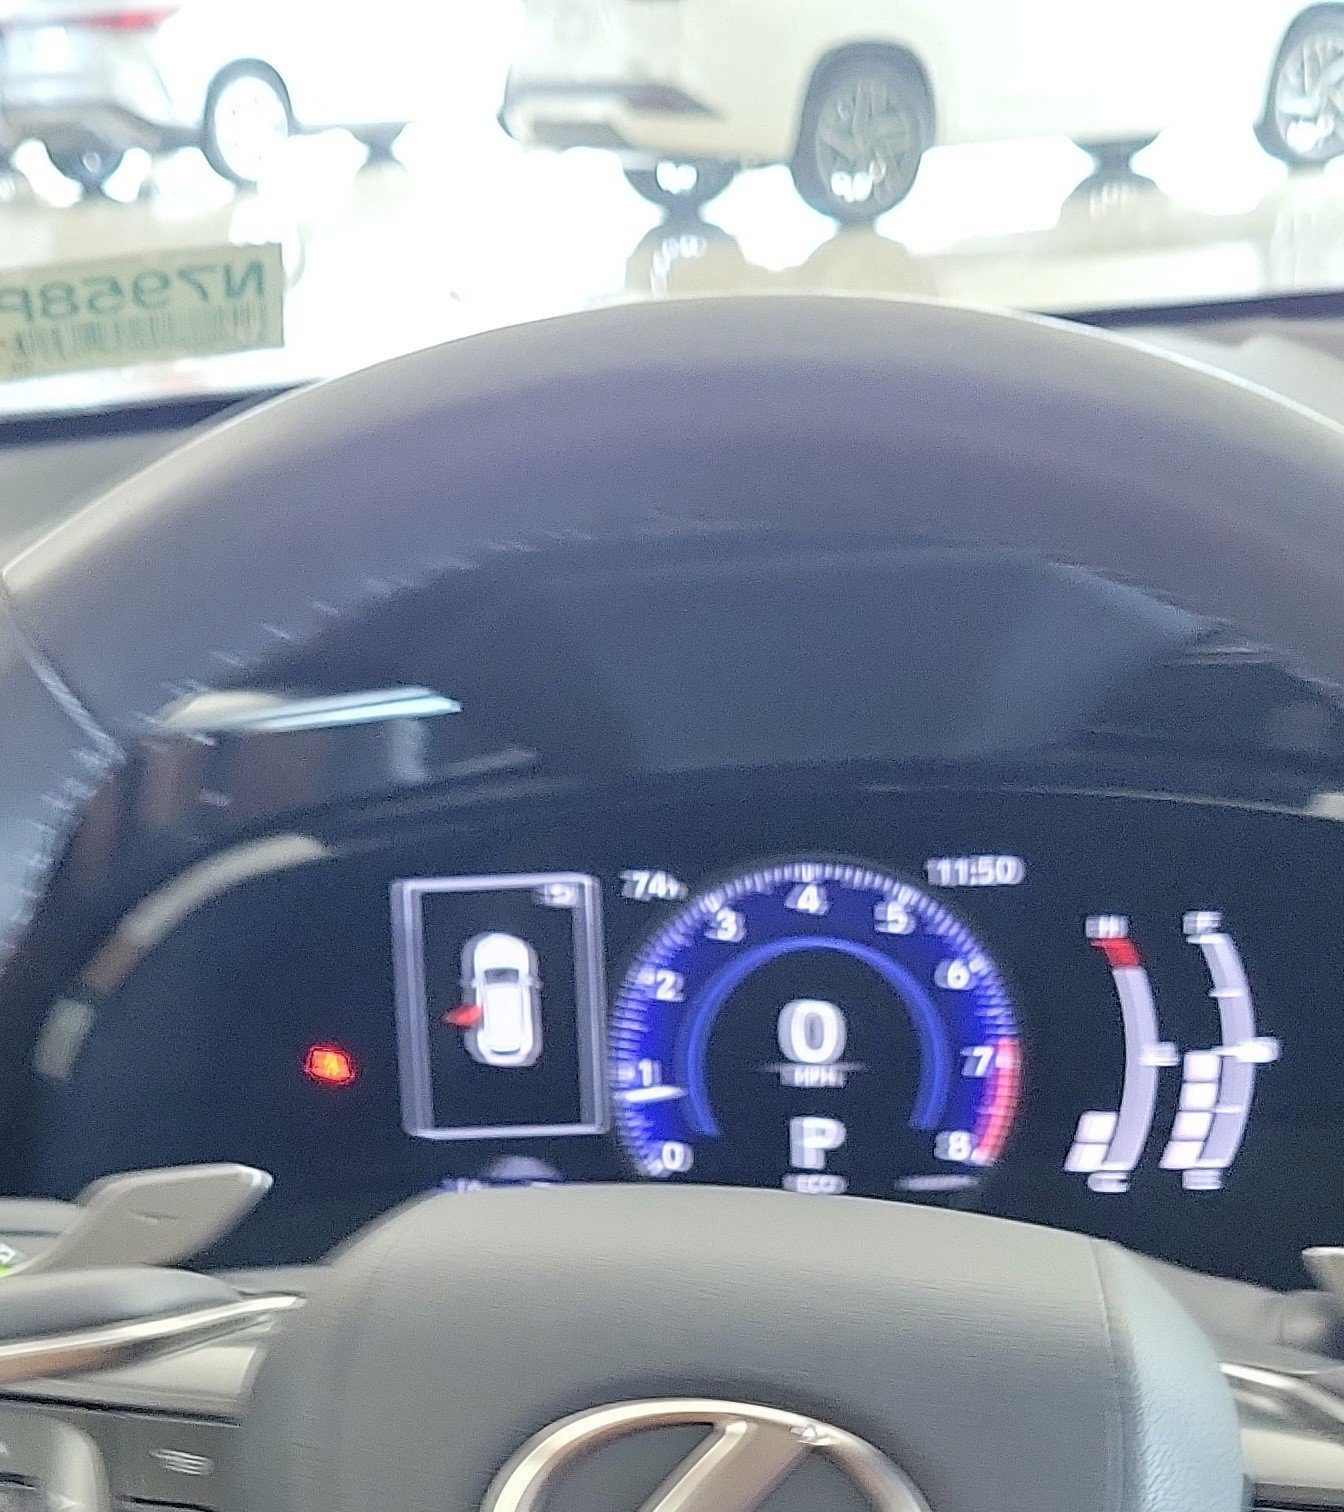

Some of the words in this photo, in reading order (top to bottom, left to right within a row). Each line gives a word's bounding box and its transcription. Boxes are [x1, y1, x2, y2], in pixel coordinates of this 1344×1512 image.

[927, 855, 1026, 886] 11:50
[792, 885, 826, 914] 4
[710, 907, 746, 942] 3
[876, 901, 916, 935] 5
[655, 968, 684, 999] 2
[936, 958, 974, 989] 6
[778, 1000, 846, 1064] 0
[964, 1045, 994, 1077] 7
[789, 1116, 846, 1169] P
[936, 1130, 975, 1162] 8
